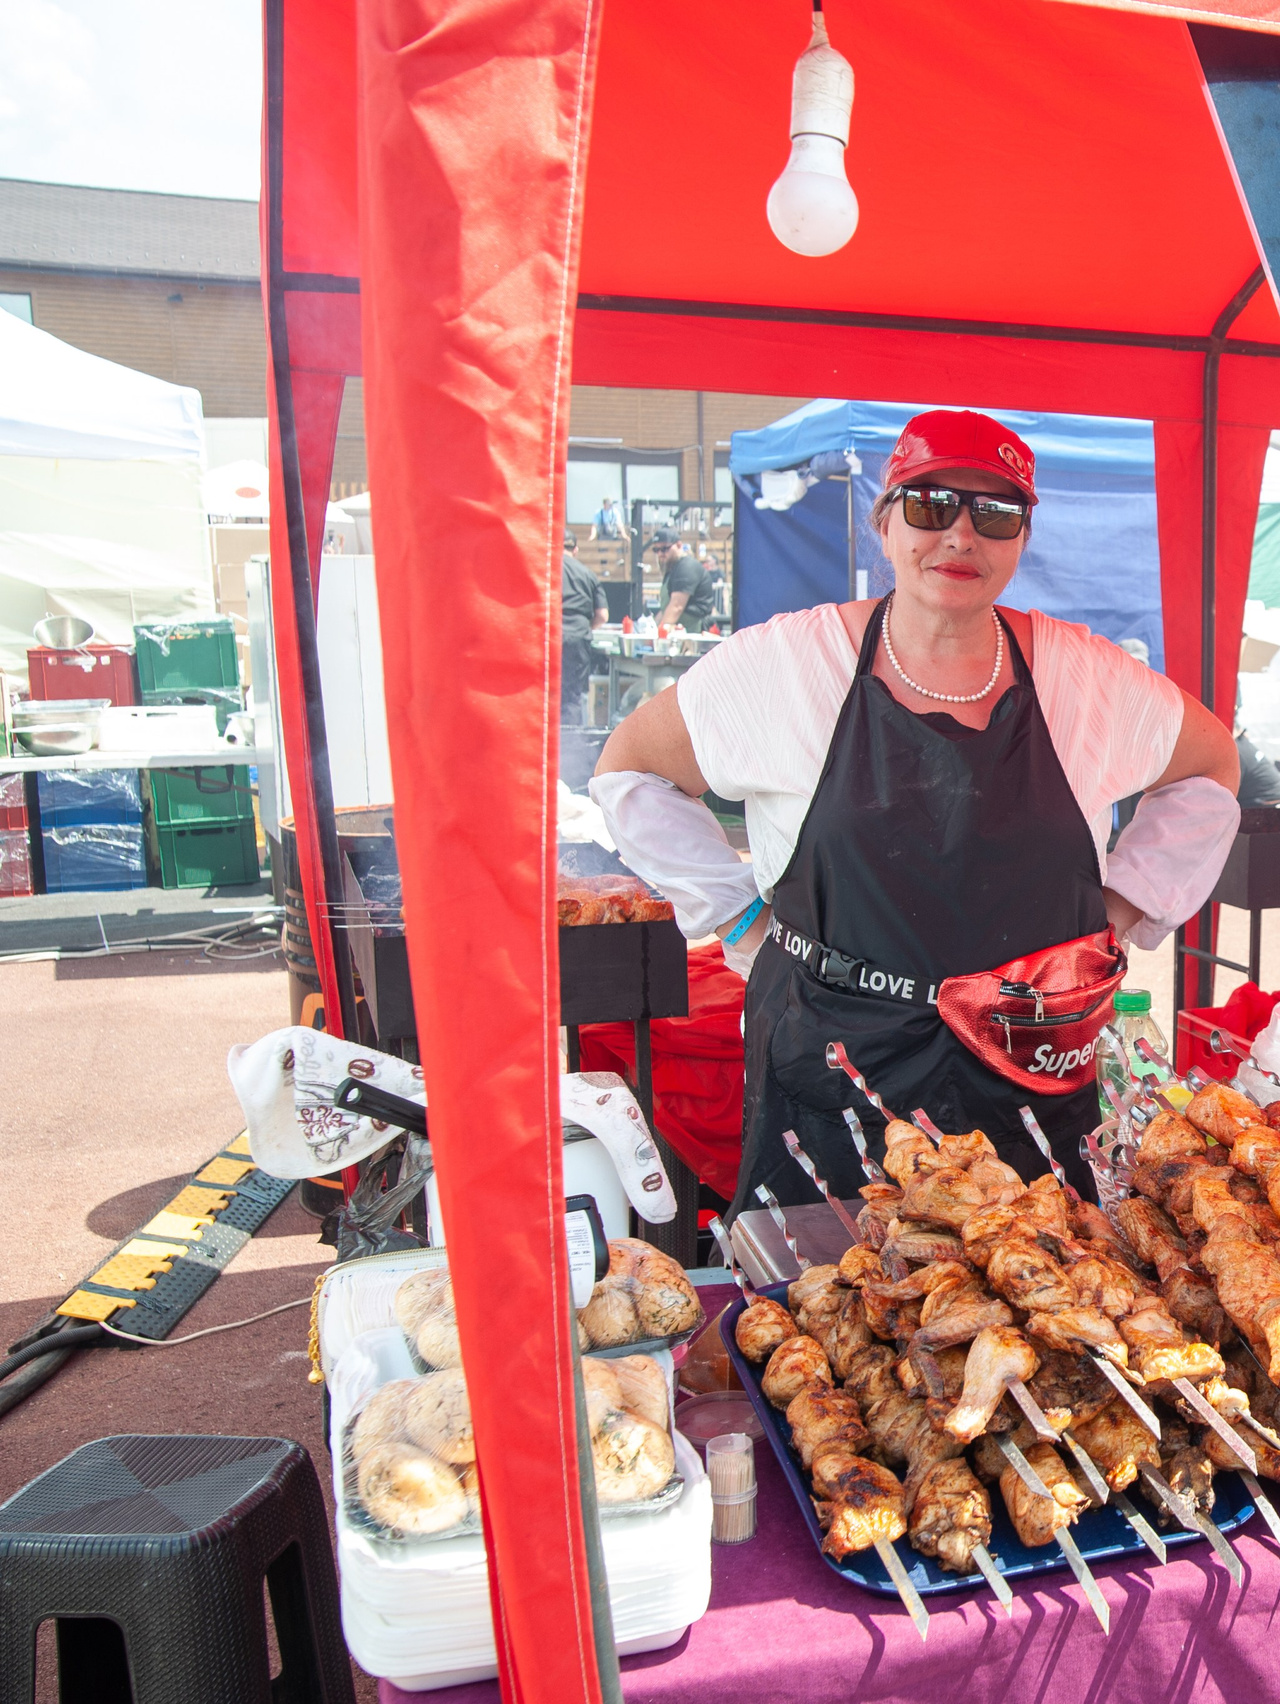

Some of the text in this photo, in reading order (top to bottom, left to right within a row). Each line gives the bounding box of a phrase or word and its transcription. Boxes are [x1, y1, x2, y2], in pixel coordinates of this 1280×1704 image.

[771, 915, 784, 944] VE
[784, 930, 812, 961] LOV
[859, 967, 916, 1000] LOVE
